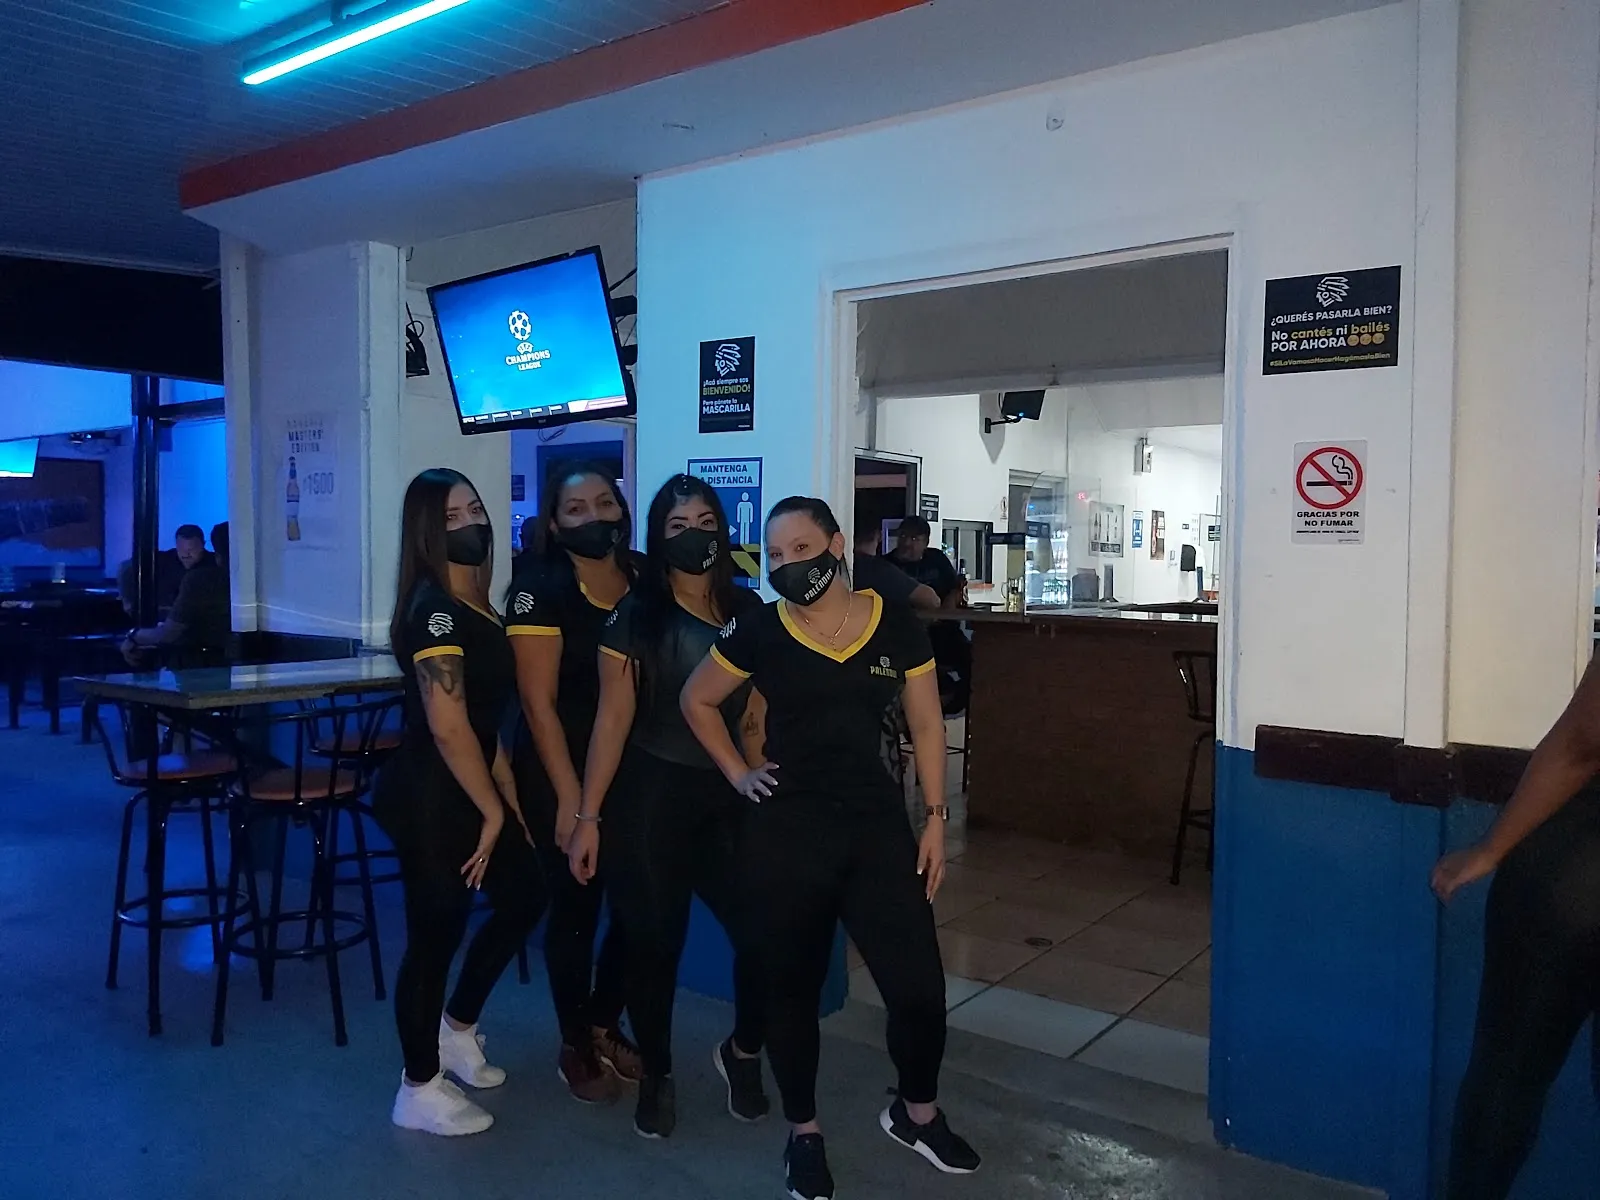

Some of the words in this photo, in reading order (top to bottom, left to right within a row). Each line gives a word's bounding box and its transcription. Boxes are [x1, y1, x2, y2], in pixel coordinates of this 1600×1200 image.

[1271, 311, 1314, 326] ¿QUERÉS
[1316, 308, 1361, 320] PASARLA
[1363, 305, 1393, 316] BIEN?
[1271, 331, 1288, 341] No
[1291, 326, 1333, 339] cantés
[1336, 325, 1348, 336] ni
[1351, 322, 1390, 334] bailés
[1271, 341, 1298, 352] POR
[1300, 337, 1346, 350] AHORA
[505, 349, 551, 366] CHAMPIONS
[517, 361, 542, 371] LEAGUE
[703, 384, 751, 396] BIENVENIDO!
[702, 403, 751, 415] MASCARILLA
[700, 464, 748, 474] MANTENGA
[707, 475, 753, 485] DISTANCIA
